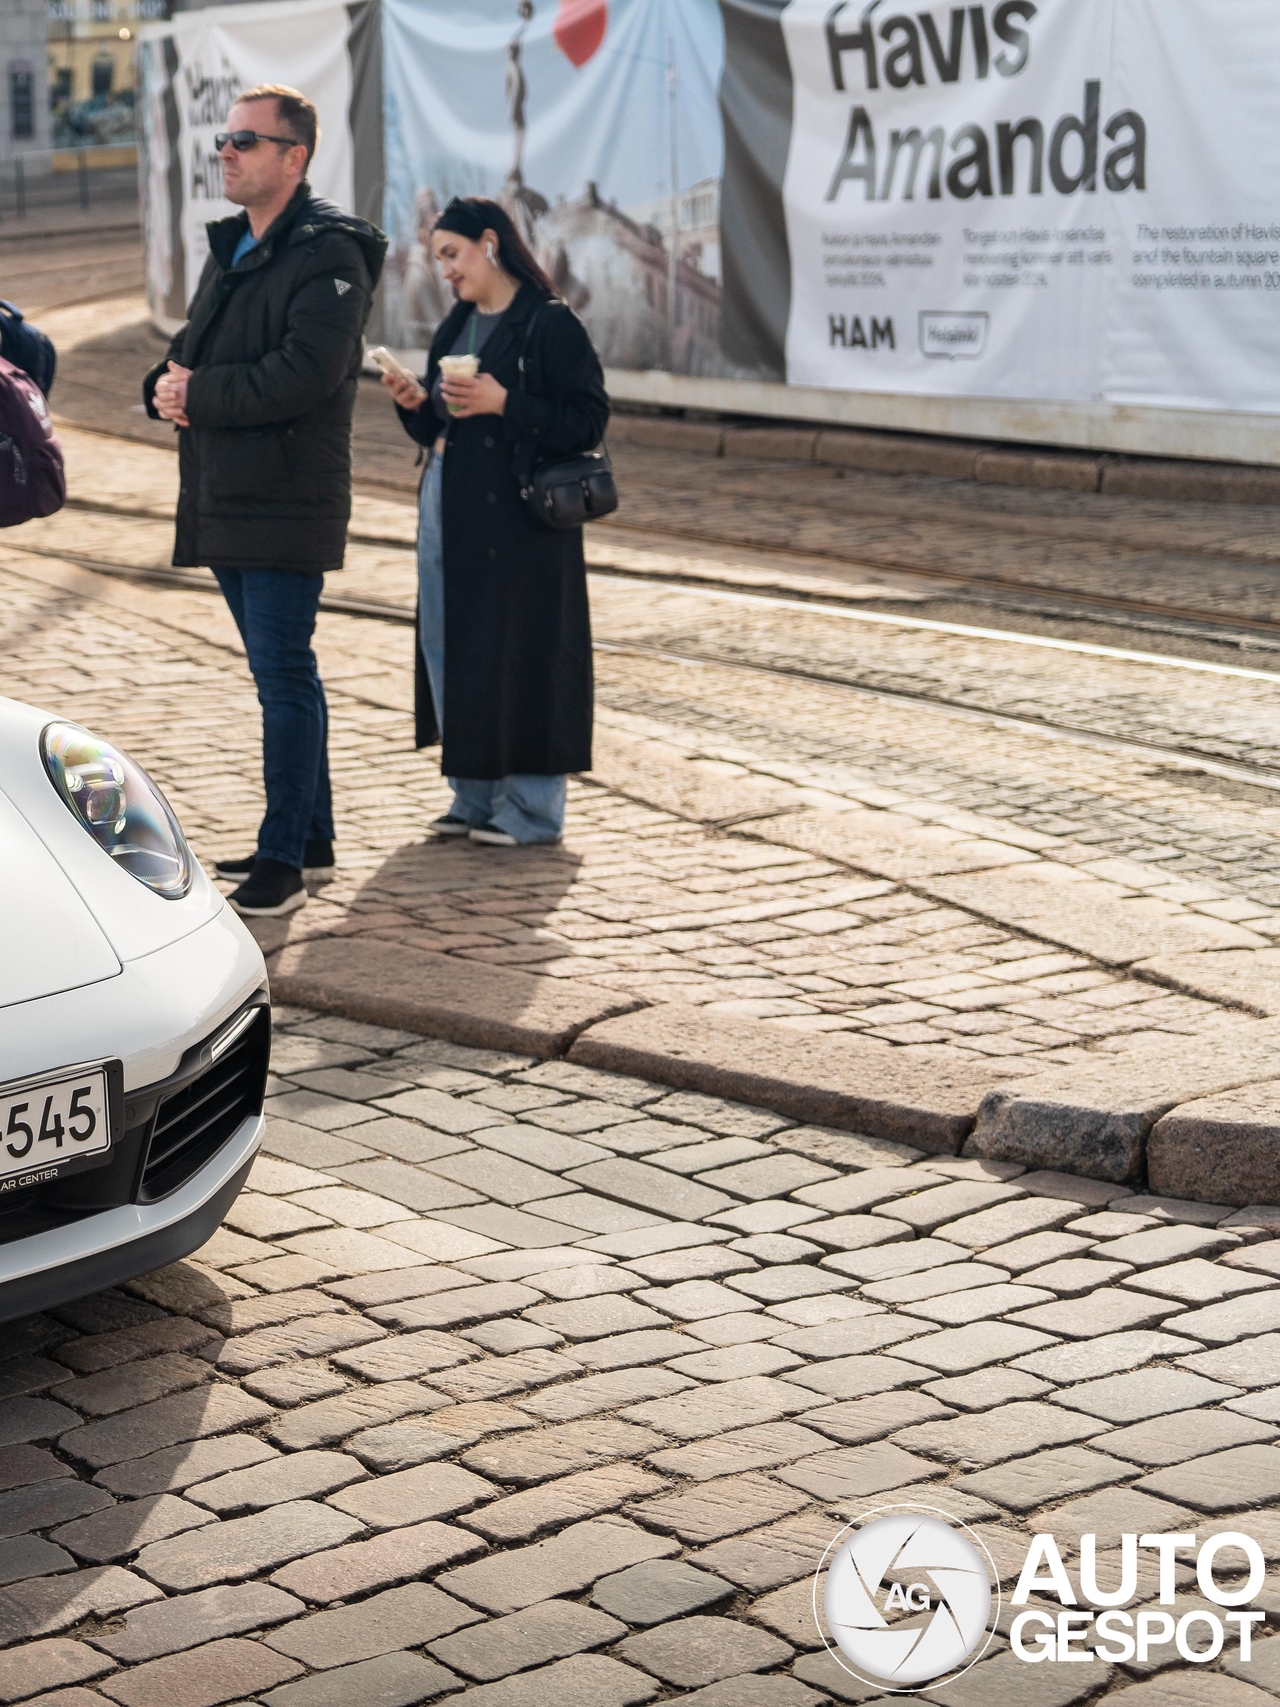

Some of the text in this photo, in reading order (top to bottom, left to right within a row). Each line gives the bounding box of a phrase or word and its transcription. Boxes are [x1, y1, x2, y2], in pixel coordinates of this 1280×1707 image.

[823, 0, 1038, 91] Havis
[823, 77, 1146, 202] Amanda
[828, 312, 896, 350] HAM
[18, 1168, 59, 1187] CENTER
